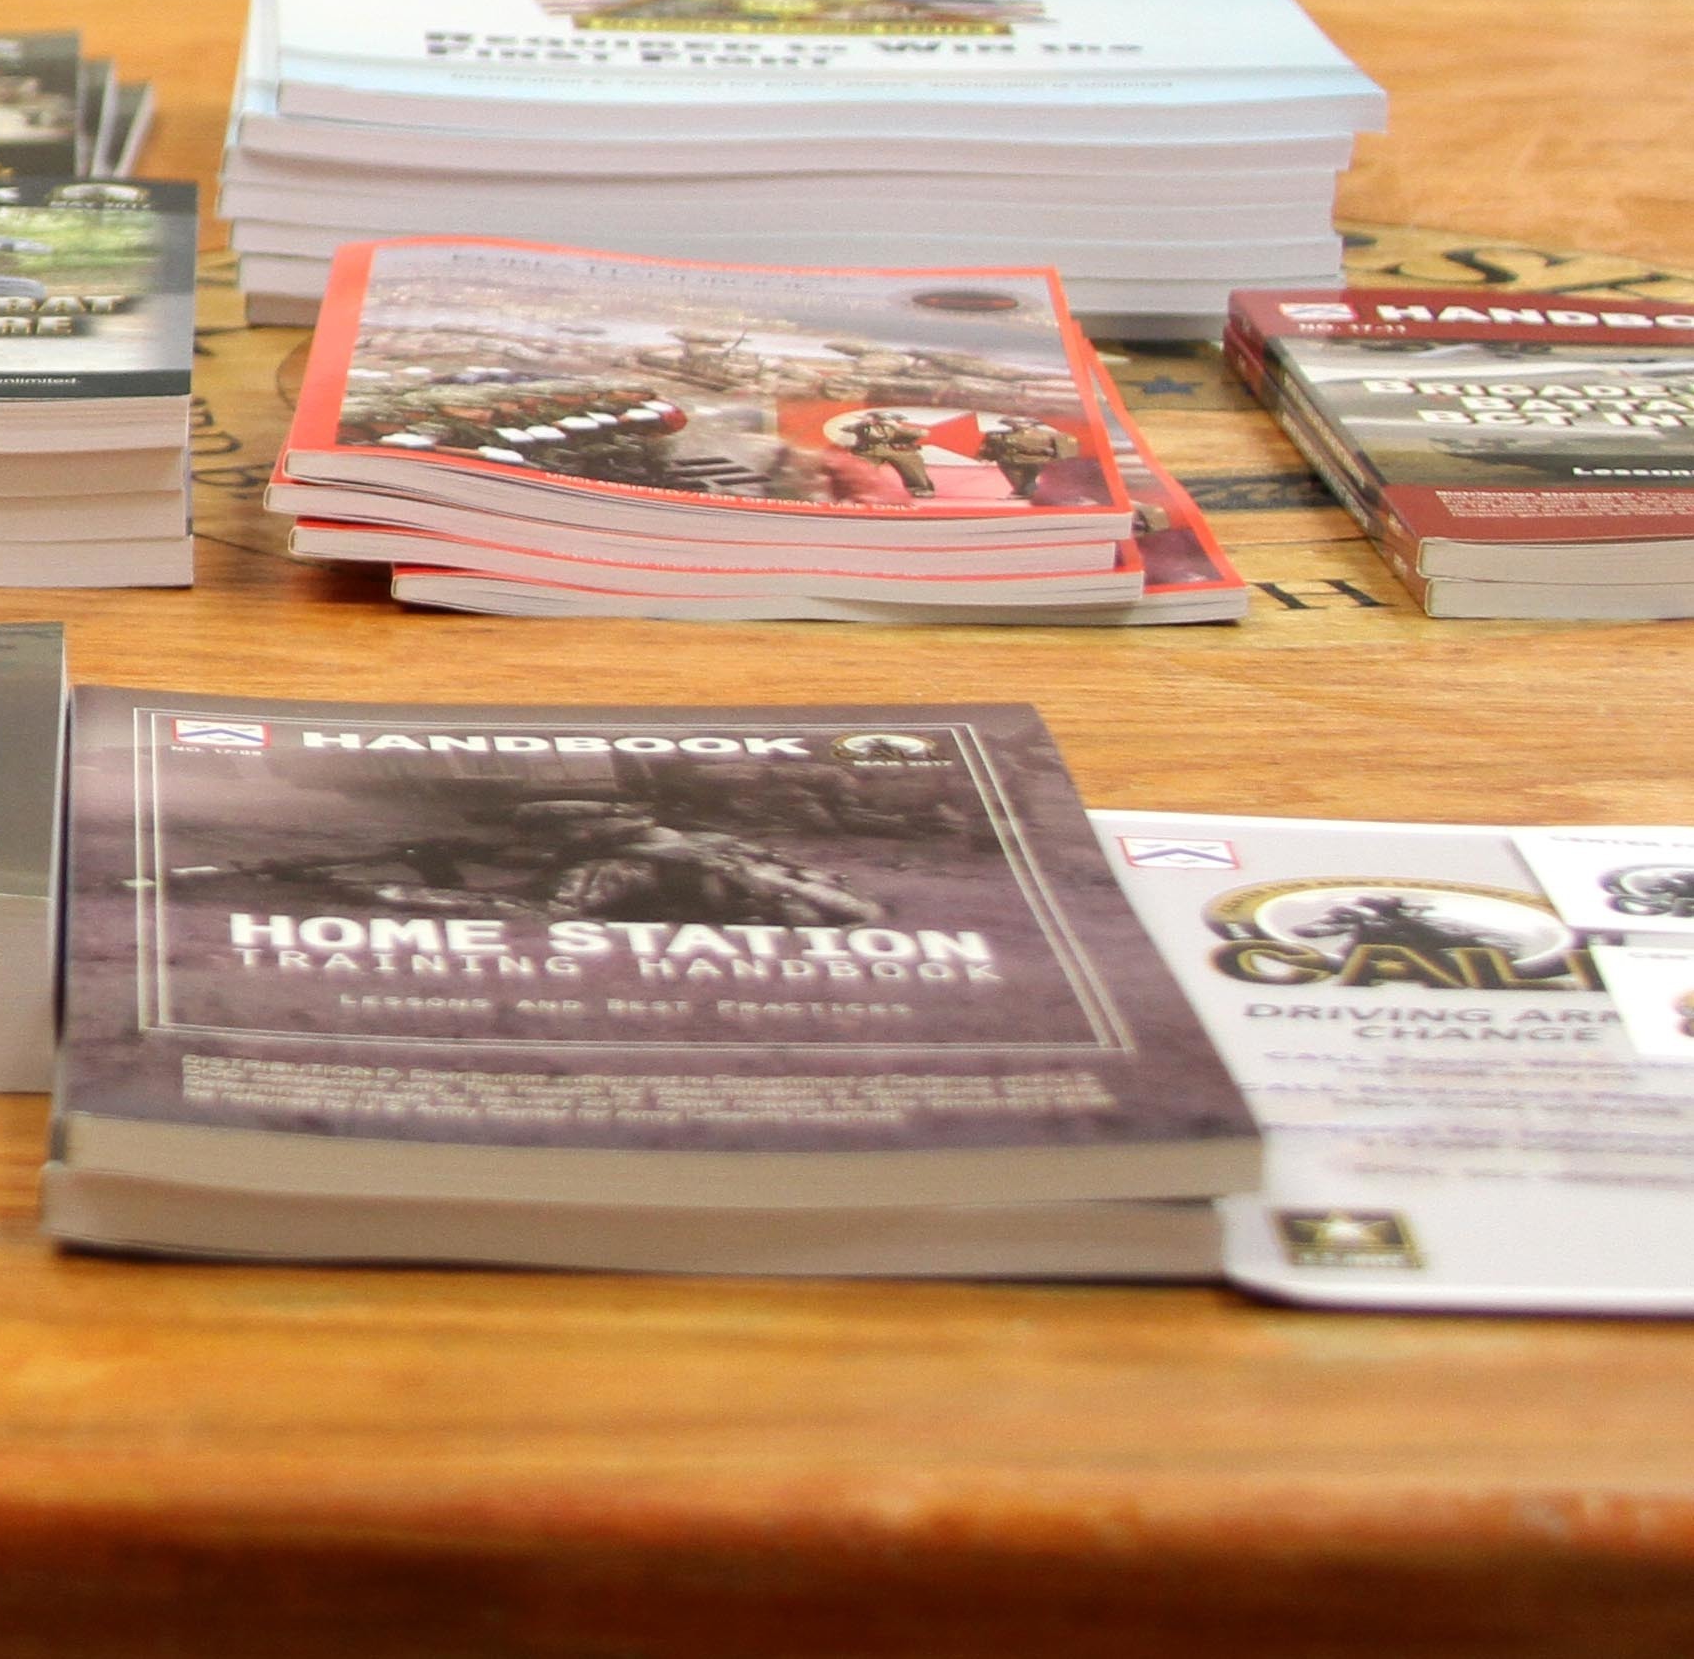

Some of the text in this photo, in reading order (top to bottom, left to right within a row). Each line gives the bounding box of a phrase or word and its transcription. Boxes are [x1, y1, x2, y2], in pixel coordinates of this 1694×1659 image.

[1362, 379, 1673, 398] BRIGADE
[1460, 396, 1694, 413] BATTA
[1417, 409, 1576, 426] BCT
[1571, 467, 1694, 477] Lesson
[301, 732, 814, 755] HANDBOOK
[229, 912, 994, 961] HOME STATION
[231, 946, 1007, 981] TRAINING HANDBOOK
[1243, 1002, 1492, 1023] DRIVING
[1352, 1025, 1606, 1042] CHANGE
